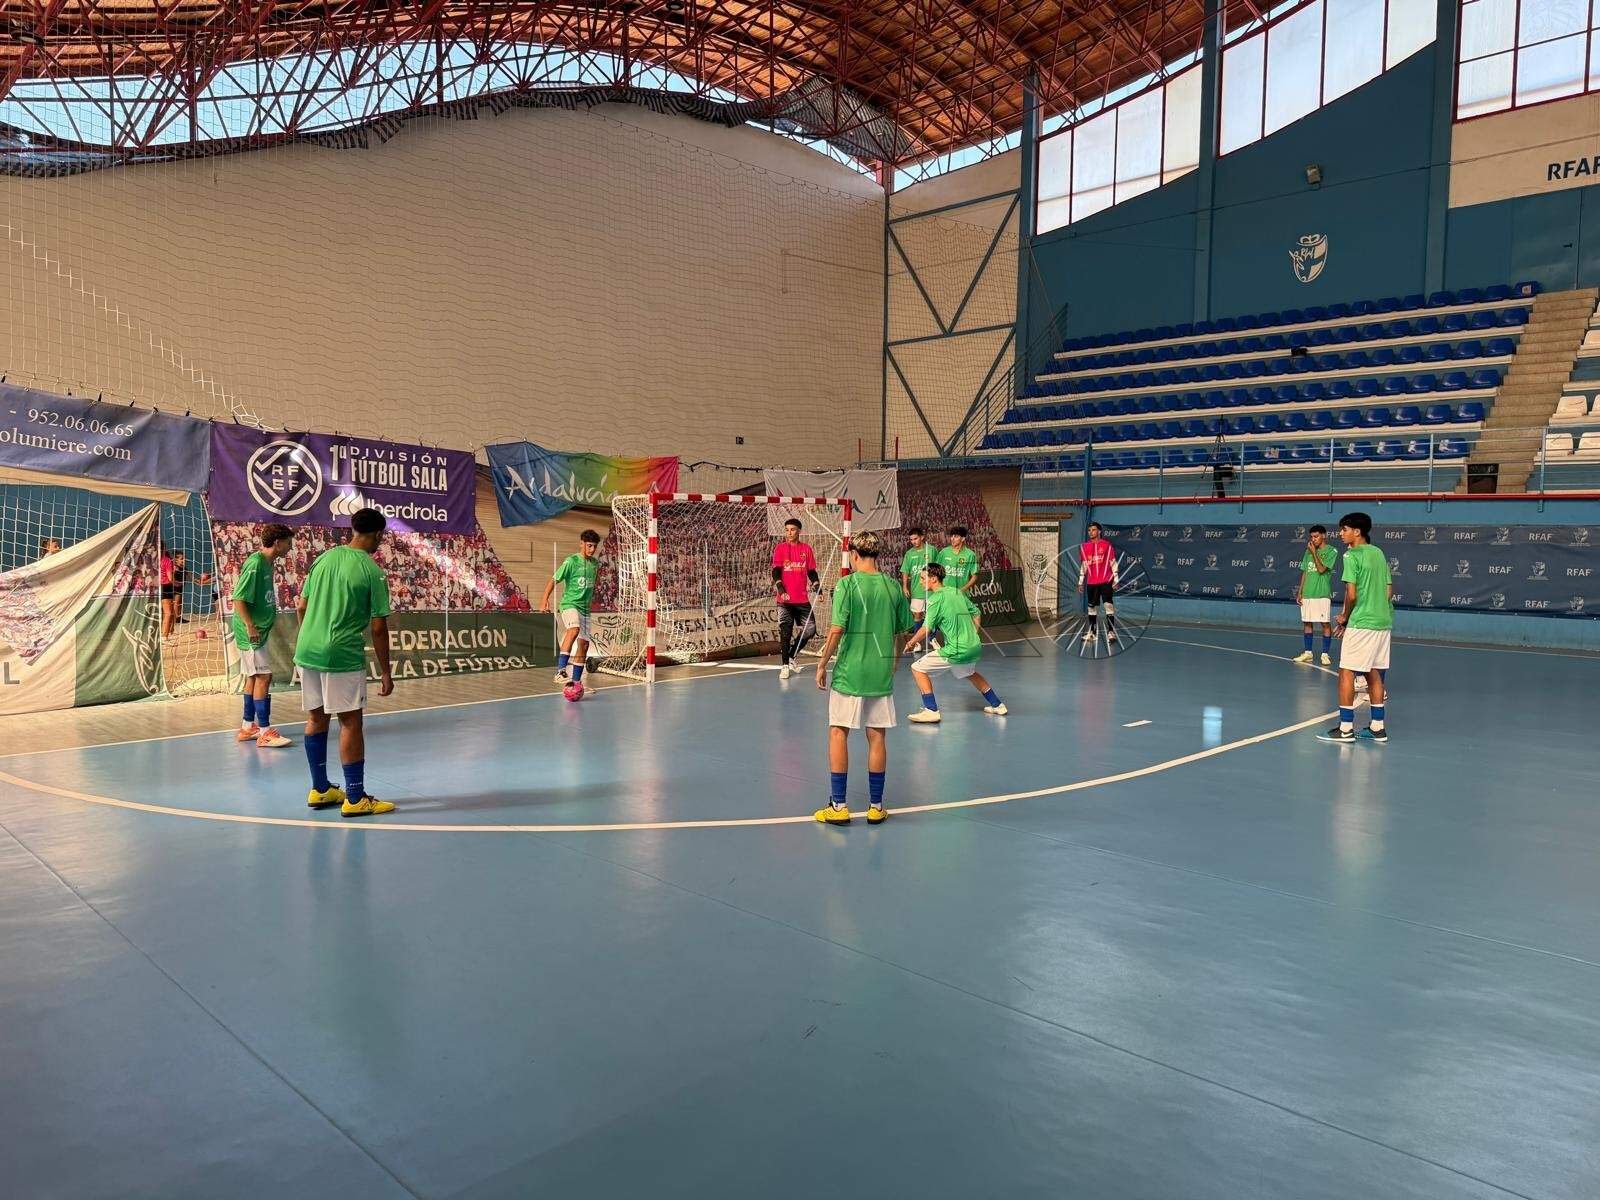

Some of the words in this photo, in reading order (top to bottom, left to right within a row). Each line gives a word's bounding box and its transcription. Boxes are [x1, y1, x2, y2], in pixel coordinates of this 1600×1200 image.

[1547, 155, 1600, 181] RFAF
[28, 408, 134, 437] 952.06.06.65
[0, 428, 132, 461] olumiere.com
[350, 446, 447, 466] DIVISIÓN
[351, 456, 407, 488] FÚTBOL
[411, 466, 448, 491] SALA
[367, 498, 448, 522] Iberdrola
[714, 609, 779, 629] FEDERAC
[388, 626, 507, 650] EDERACIÓN
[422, 657, 451, 677] DE
[456, 653, 536, 673] FÚTBOL
